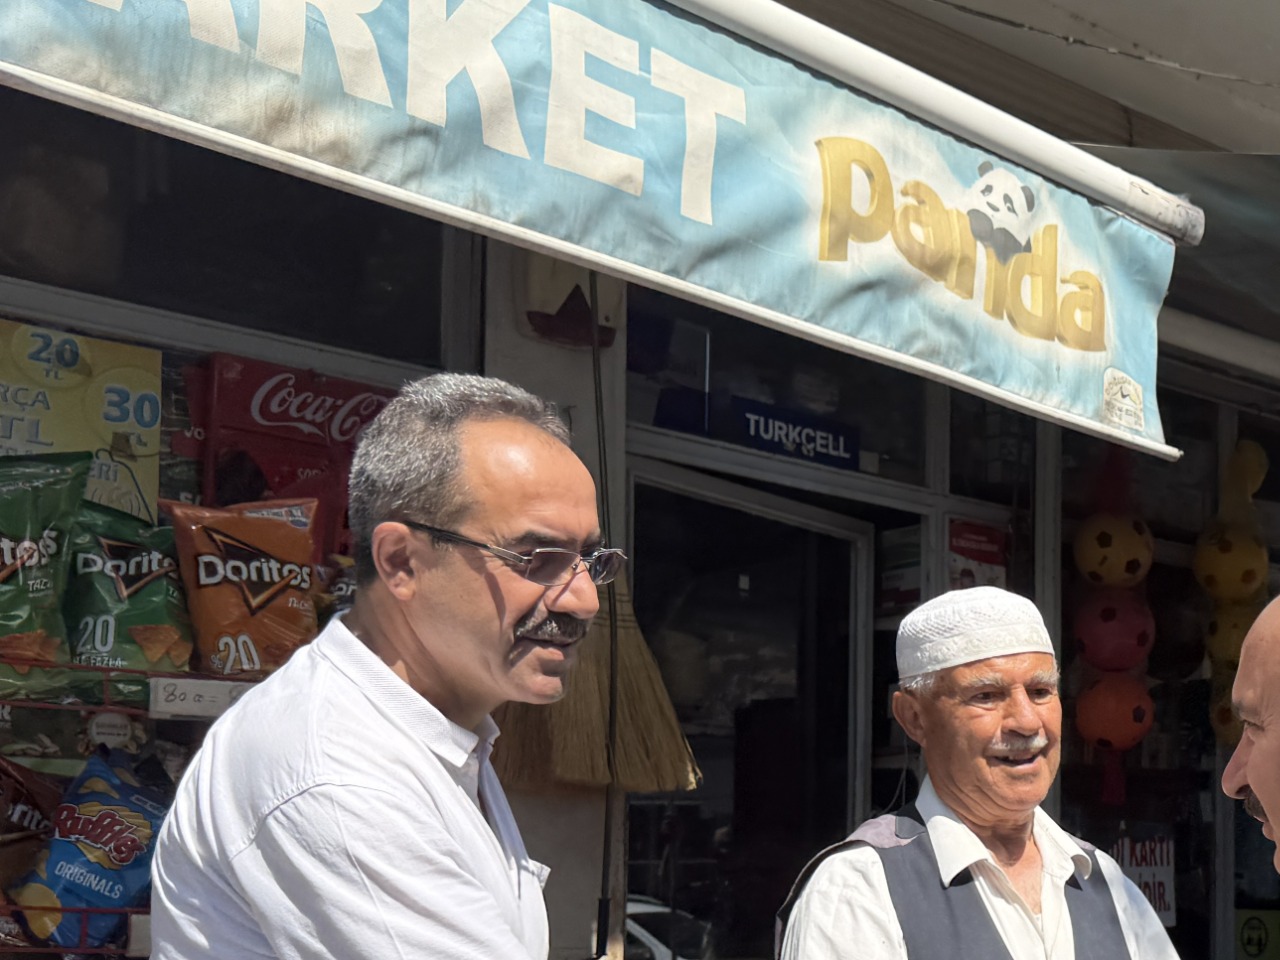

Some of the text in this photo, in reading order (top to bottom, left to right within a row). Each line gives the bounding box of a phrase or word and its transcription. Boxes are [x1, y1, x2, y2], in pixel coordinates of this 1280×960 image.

[28, 331, 81, 368] 20
[103, 385, 160, 429] 30
[745, 412, 852, 460] TURKCELL
[198, 553, 311, 590] Doritos
[76, 614, 116, 653] 20
[53, 803, 147, 865] Ruffles
[54, 860, 124, 900] ORIGINALS
